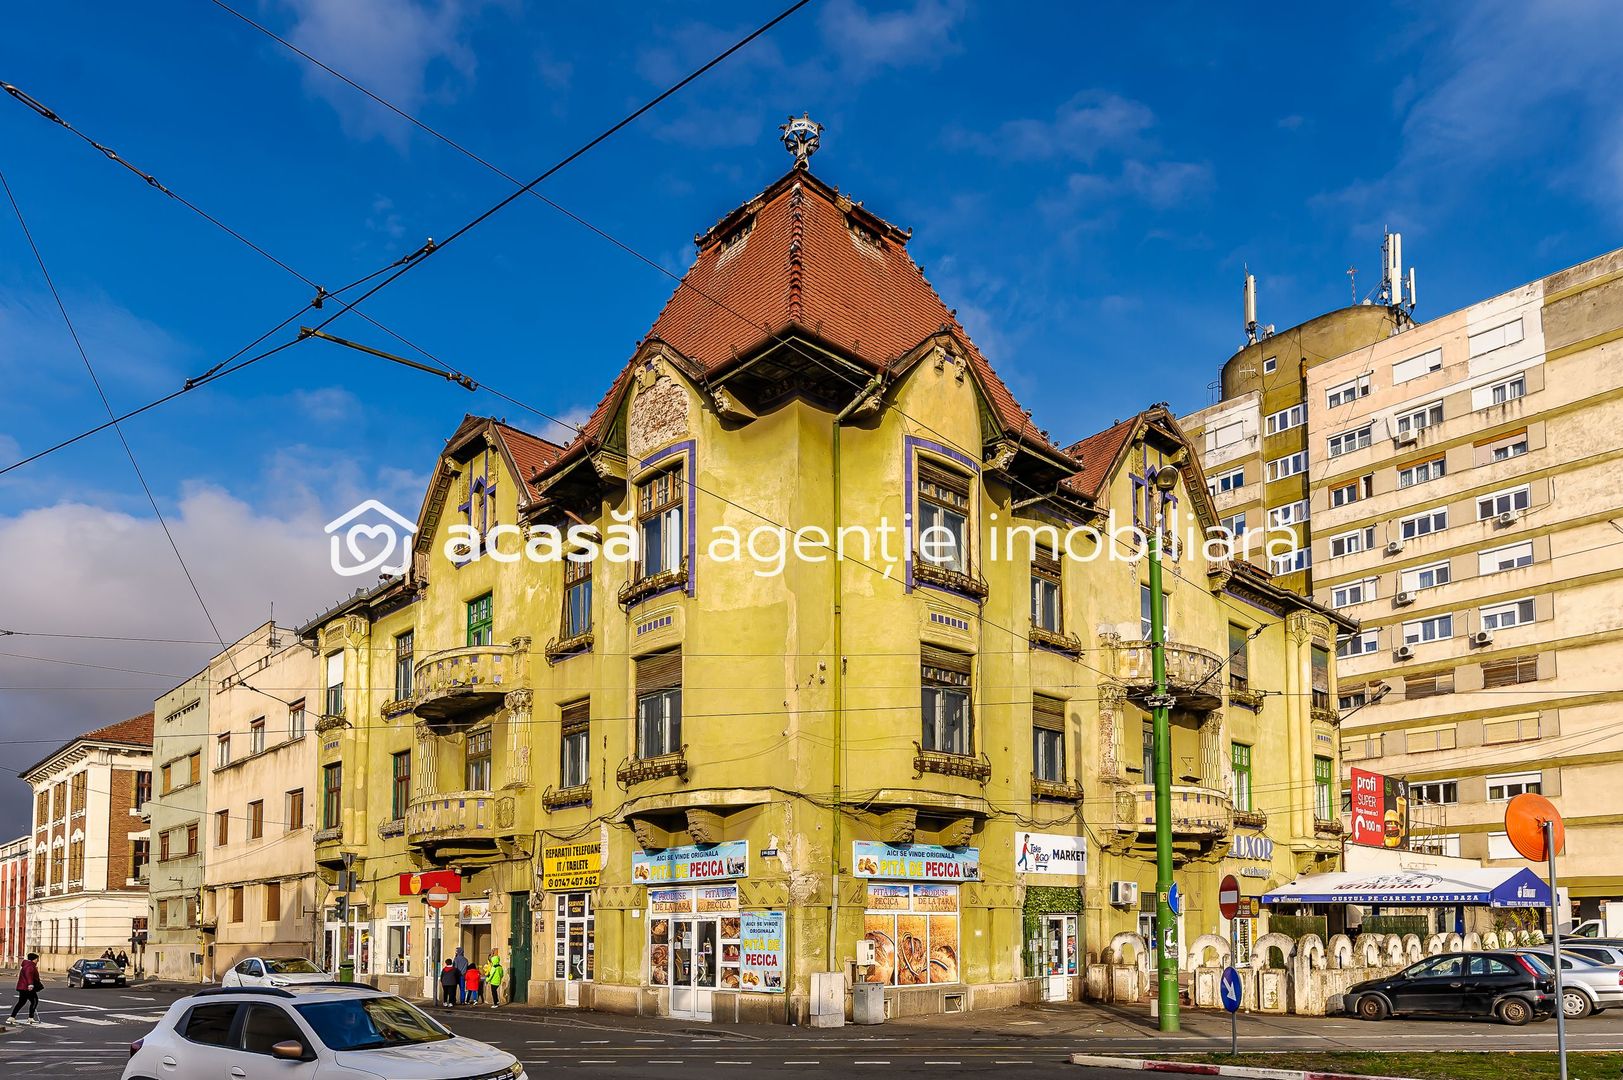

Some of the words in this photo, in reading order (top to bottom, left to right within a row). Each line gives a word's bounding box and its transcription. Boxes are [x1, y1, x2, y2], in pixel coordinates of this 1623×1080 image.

[1357, 776, 1376, 792] profi
[1357, 793, 1377, 808] SUPER
[1366, 820, 1375, 832] 100
[1376, 824, 1381, 833] m
[572, 843, 601, 857] TELEFOANE
[886, 849, 899, 857] AICI
[908, 850, 926, 858] VINDE
[1228, 834, 1274, 861] LUXOR
[675, 852, 690, 861] VINDE
[1052, 849, 1085, 862] MARKET
[567, 859, 589, 871] TABLETE
[675, 863, 688, 879] DE
[690, 860, 724, 878] PECICA
[909, 860, 923, 877] DE
[925, 861, 960, 878] PECICA
[554, 878, 570, 888] 0747
[655, 903, 663, 911] DE
[875, 897, 898, 906] PECICA
[918, 897, 927, 905] DE
[928, 897, 936, 905] LA
[767, 938, 780, 951] DE
[745, 953, 778, 967] PECICA
